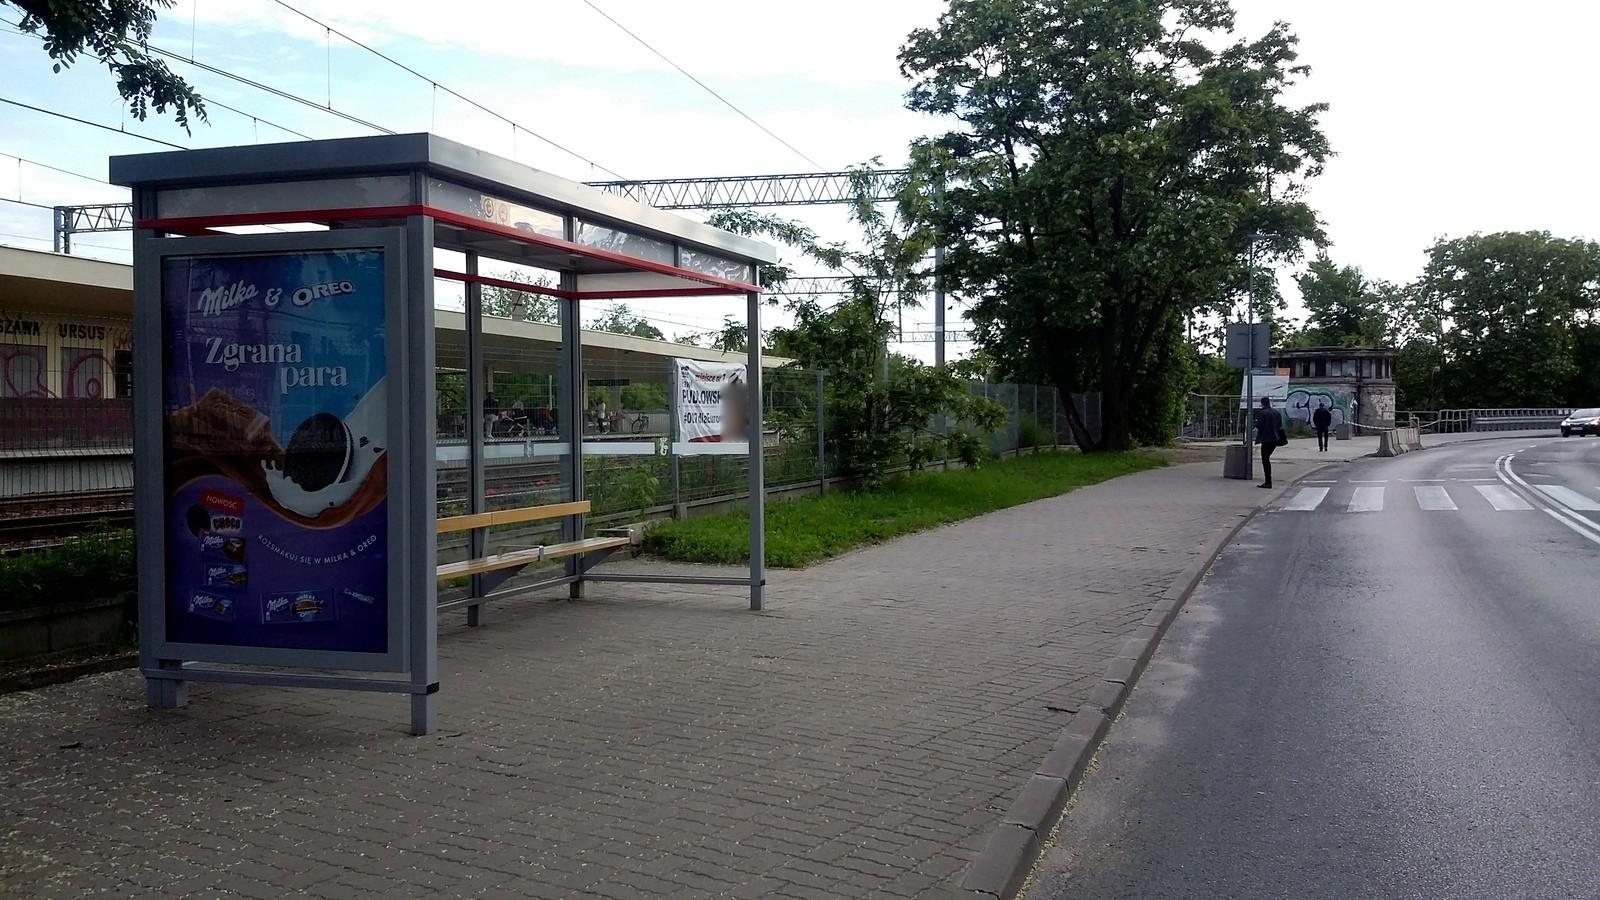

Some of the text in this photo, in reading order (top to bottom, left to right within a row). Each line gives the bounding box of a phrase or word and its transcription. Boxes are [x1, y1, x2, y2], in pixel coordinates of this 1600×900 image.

[198, 279, 354, 317] Milka & OREO
[58, 323, 105, 341] URSUS
[205, 337, 303, 372] Zgrana
[280, 366, 349, 394] para
[213, 516, 241, 530] CHOCO
[313, 556, 322, 565] W
[324, 551, 349, 565] MILKA
[350, 548, 357, 557] &
[357, 533, 378, 553] OREO
